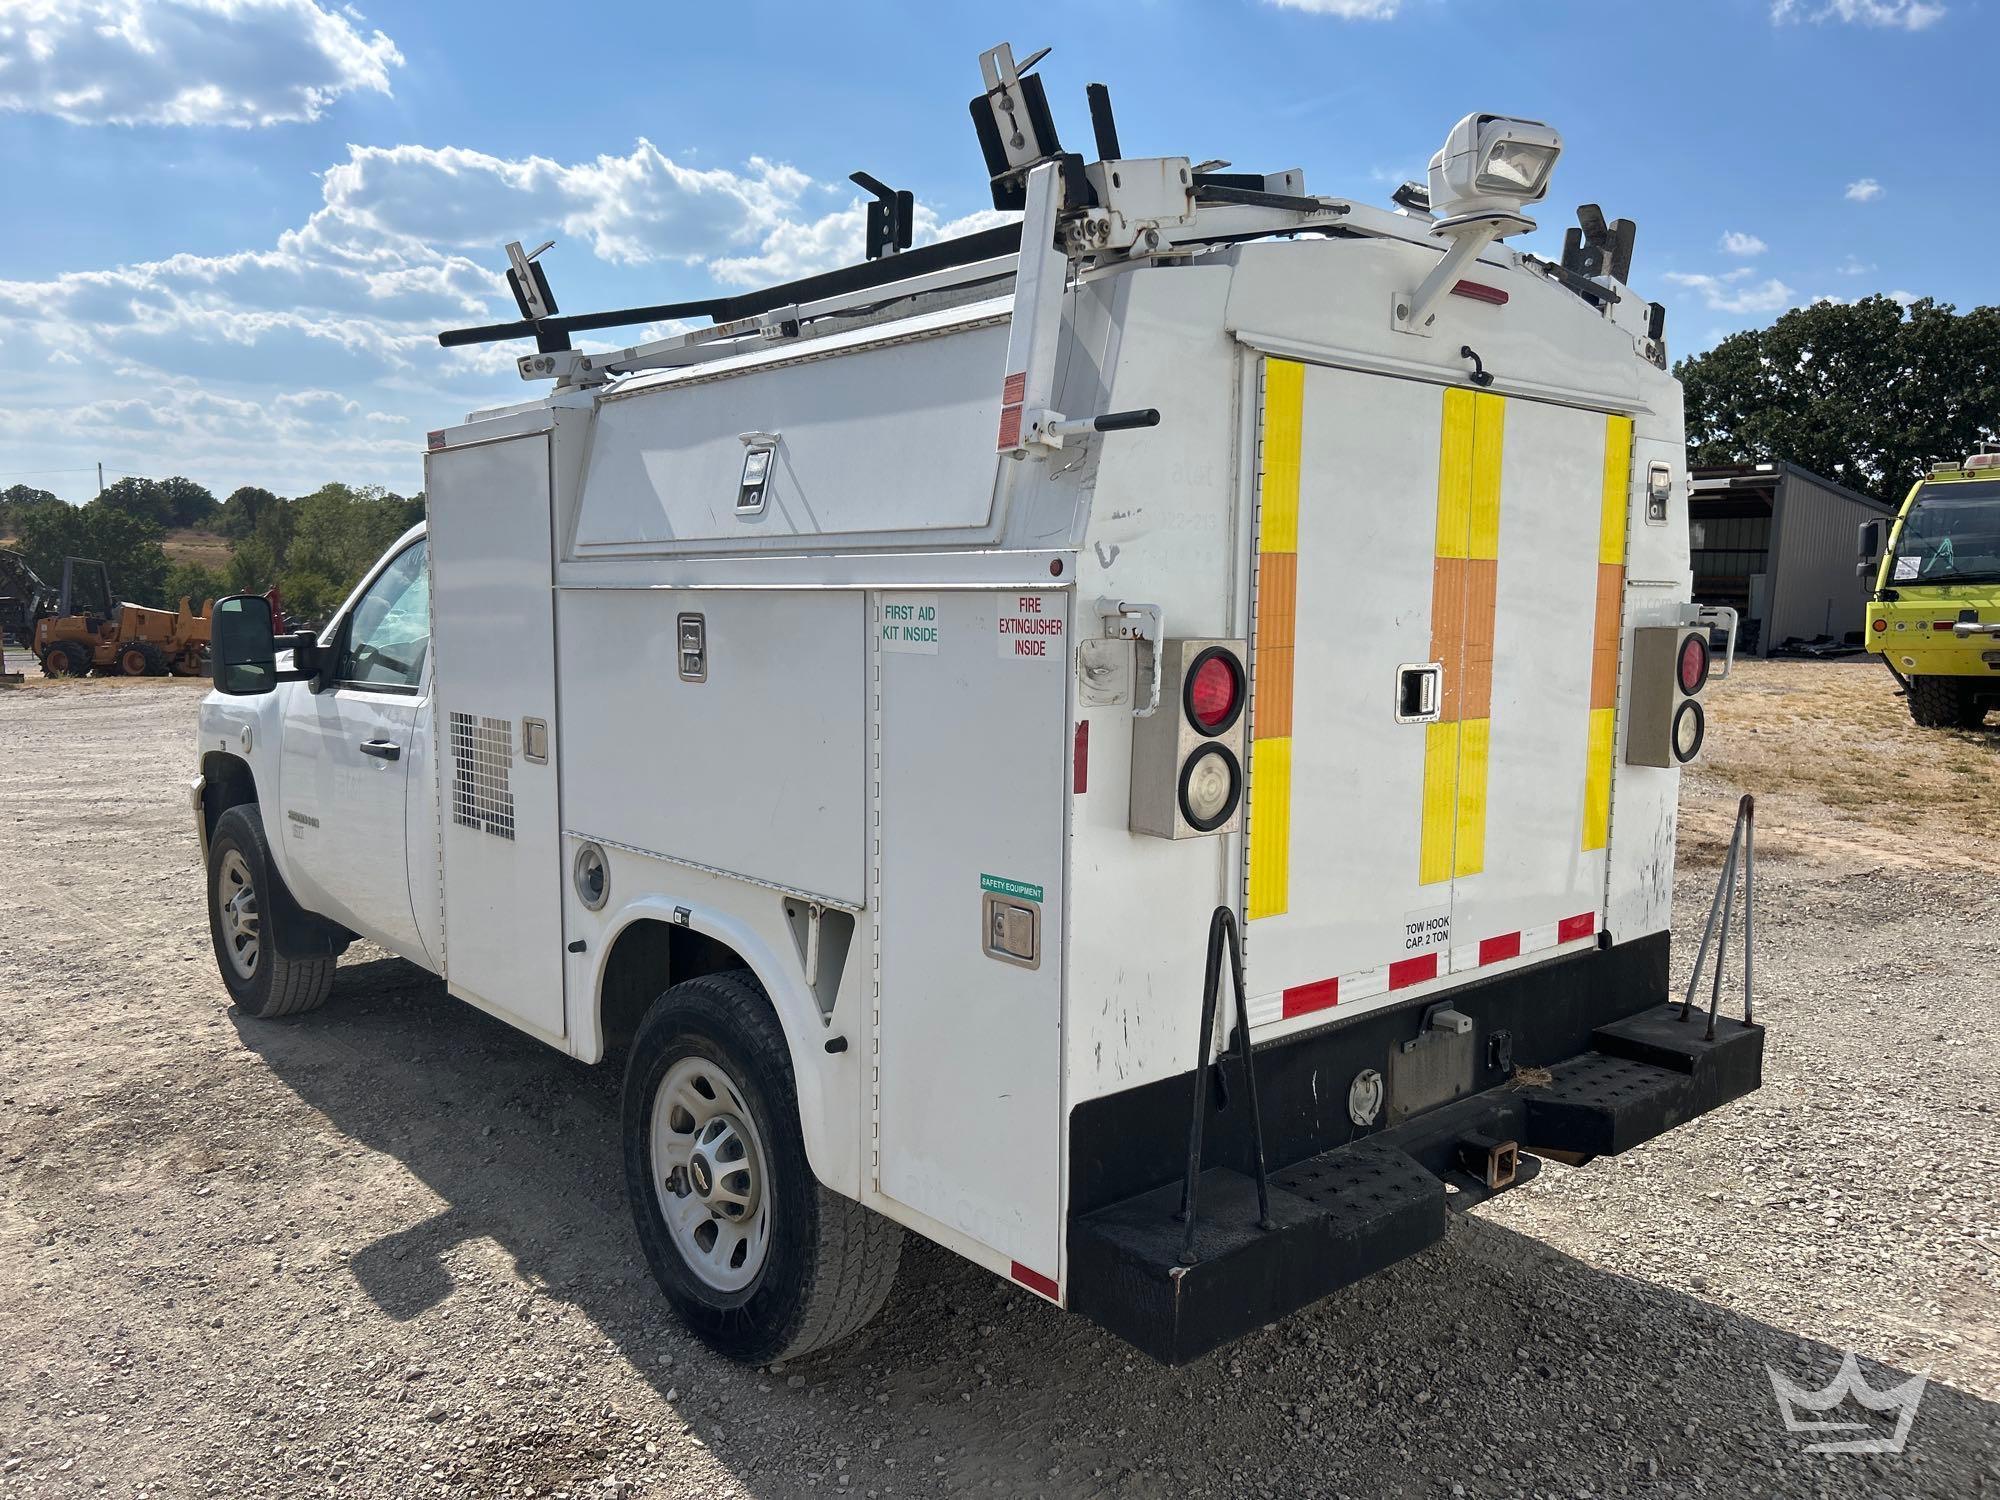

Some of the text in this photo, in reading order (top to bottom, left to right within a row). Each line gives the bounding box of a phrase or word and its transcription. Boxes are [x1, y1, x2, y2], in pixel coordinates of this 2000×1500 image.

[885, 605, 936, 621] FIRST AID
[1019, 597, 1042, 613] FIRE
[882, 626, 938, 642] KIT INSIDE
[999, 618, 1063, 636] EXTINGUISHER
[1015, 639, 1046, 657] INSIDE
[982, 878, 1041, 897] SAFETY EQUIPMENT
[1406, 916, 1449, 935] TOW HOOK
[1406, 930, 1448, 949] CAP. 2 TON
